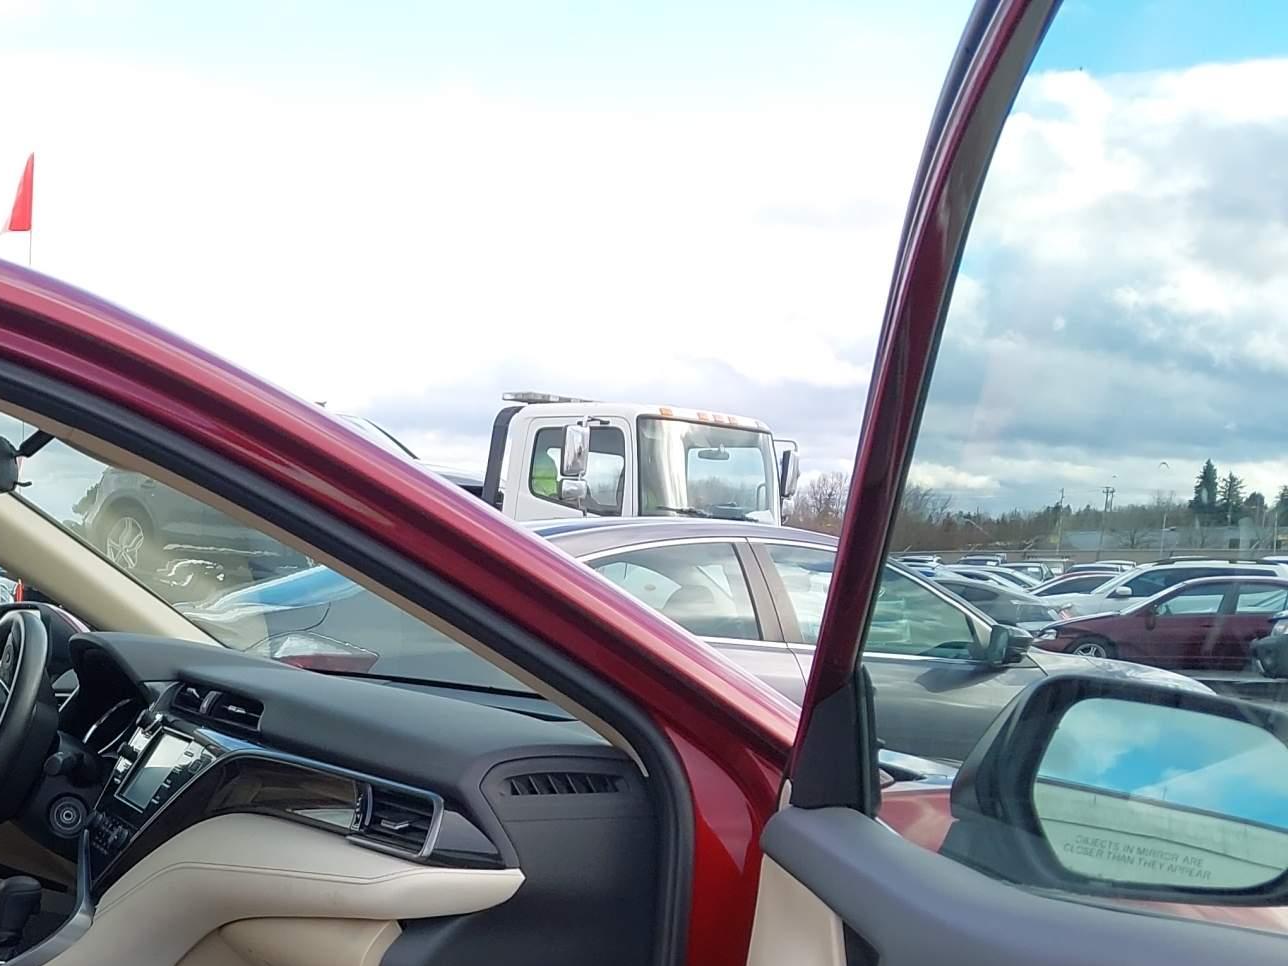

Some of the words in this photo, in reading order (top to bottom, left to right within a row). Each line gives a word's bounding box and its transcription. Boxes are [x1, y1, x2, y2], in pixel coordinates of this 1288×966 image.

[1063, 843, 1104, 857] CLOSER
[1106, 850, 1135, 865] THAN
[1136, 857, 1165, 870] THEY
[1167, 863, 1212, 880] APPEAR
[1075, 835, 1120, 849] OBJECTS
[1122, 845, 1135, 853] IN
[1136, 847, 1179, 862] MIRROR
[1182, 855, 1204, 867] ARE
